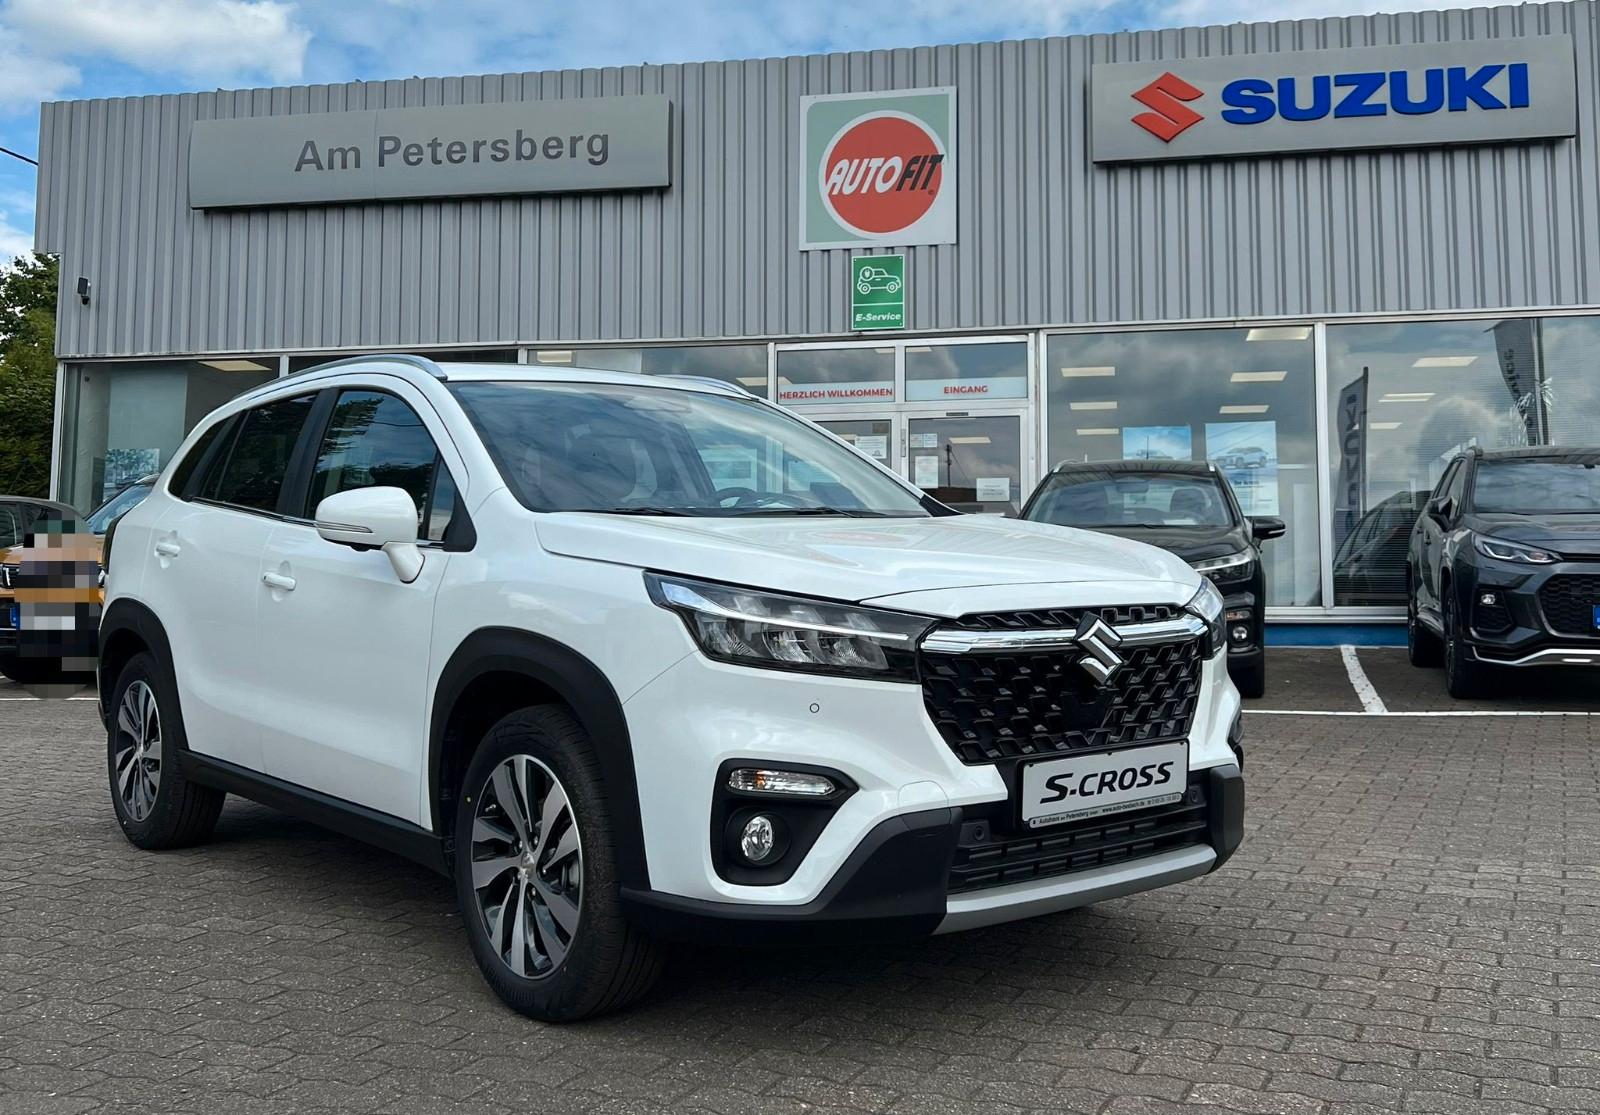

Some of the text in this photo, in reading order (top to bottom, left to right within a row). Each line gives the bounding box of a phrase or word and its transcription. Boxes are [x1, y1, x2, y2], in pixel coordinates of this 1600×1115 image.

[1221, 63, 1530, 125] SUZUKI
[294, 129, 609, 172] Am Petersberg
[826, 154, 944, 195] AUTOFIT
[855, 313, 902, 322] E-Service
[780, 388, 893, 399] HERZLICH WILLKOMMEN
[944, 385, 988, 394] EINGANG
[1040, 761, 1174, 804] S-CROSS
